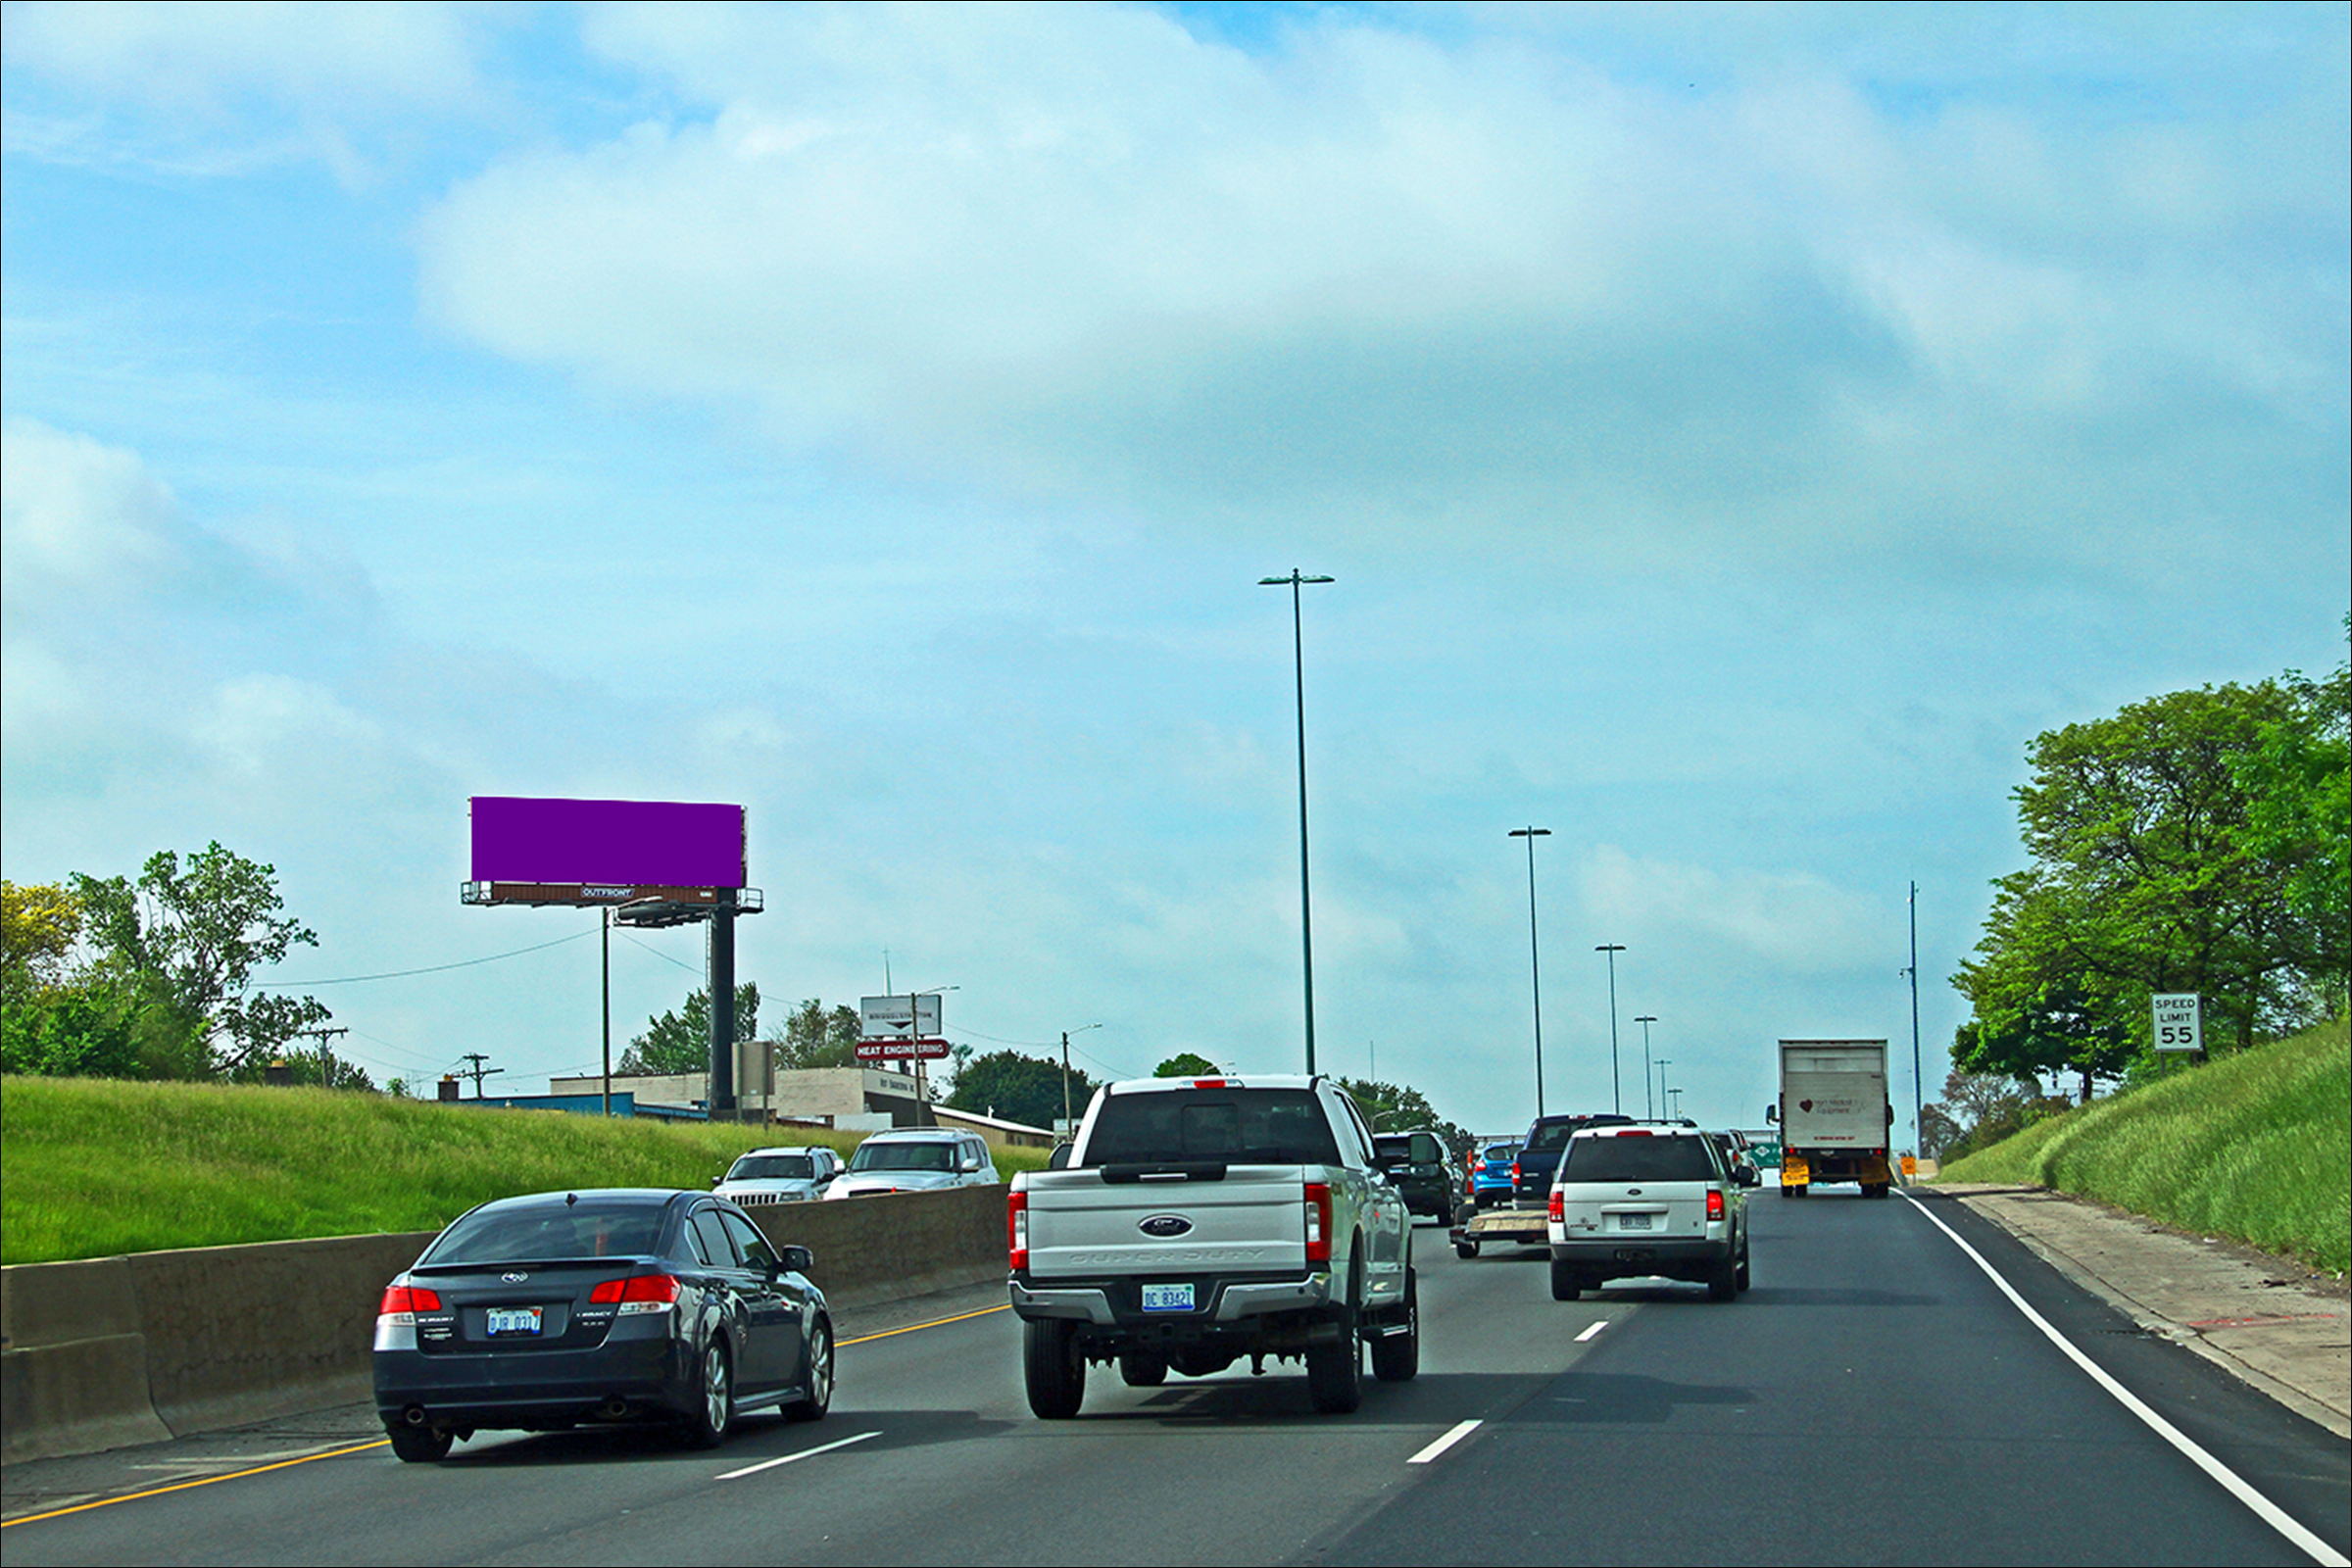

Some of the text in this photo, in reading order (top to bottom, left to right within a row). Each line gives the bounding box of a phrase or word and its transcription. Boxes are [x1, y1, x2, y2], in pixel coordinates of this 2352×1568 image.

[582, 887, 634, 897] OUTFRONT
[2155, 999, 2195, 1009] SPEED
[2160, 1012, 2191, 1022] LIMIT
[2161, 1026, 2192, 1044] 55
[858, 1044, 944, 1055] HEAT ENGINERING
[1183, 1249, 1264, 1262] DUTY
